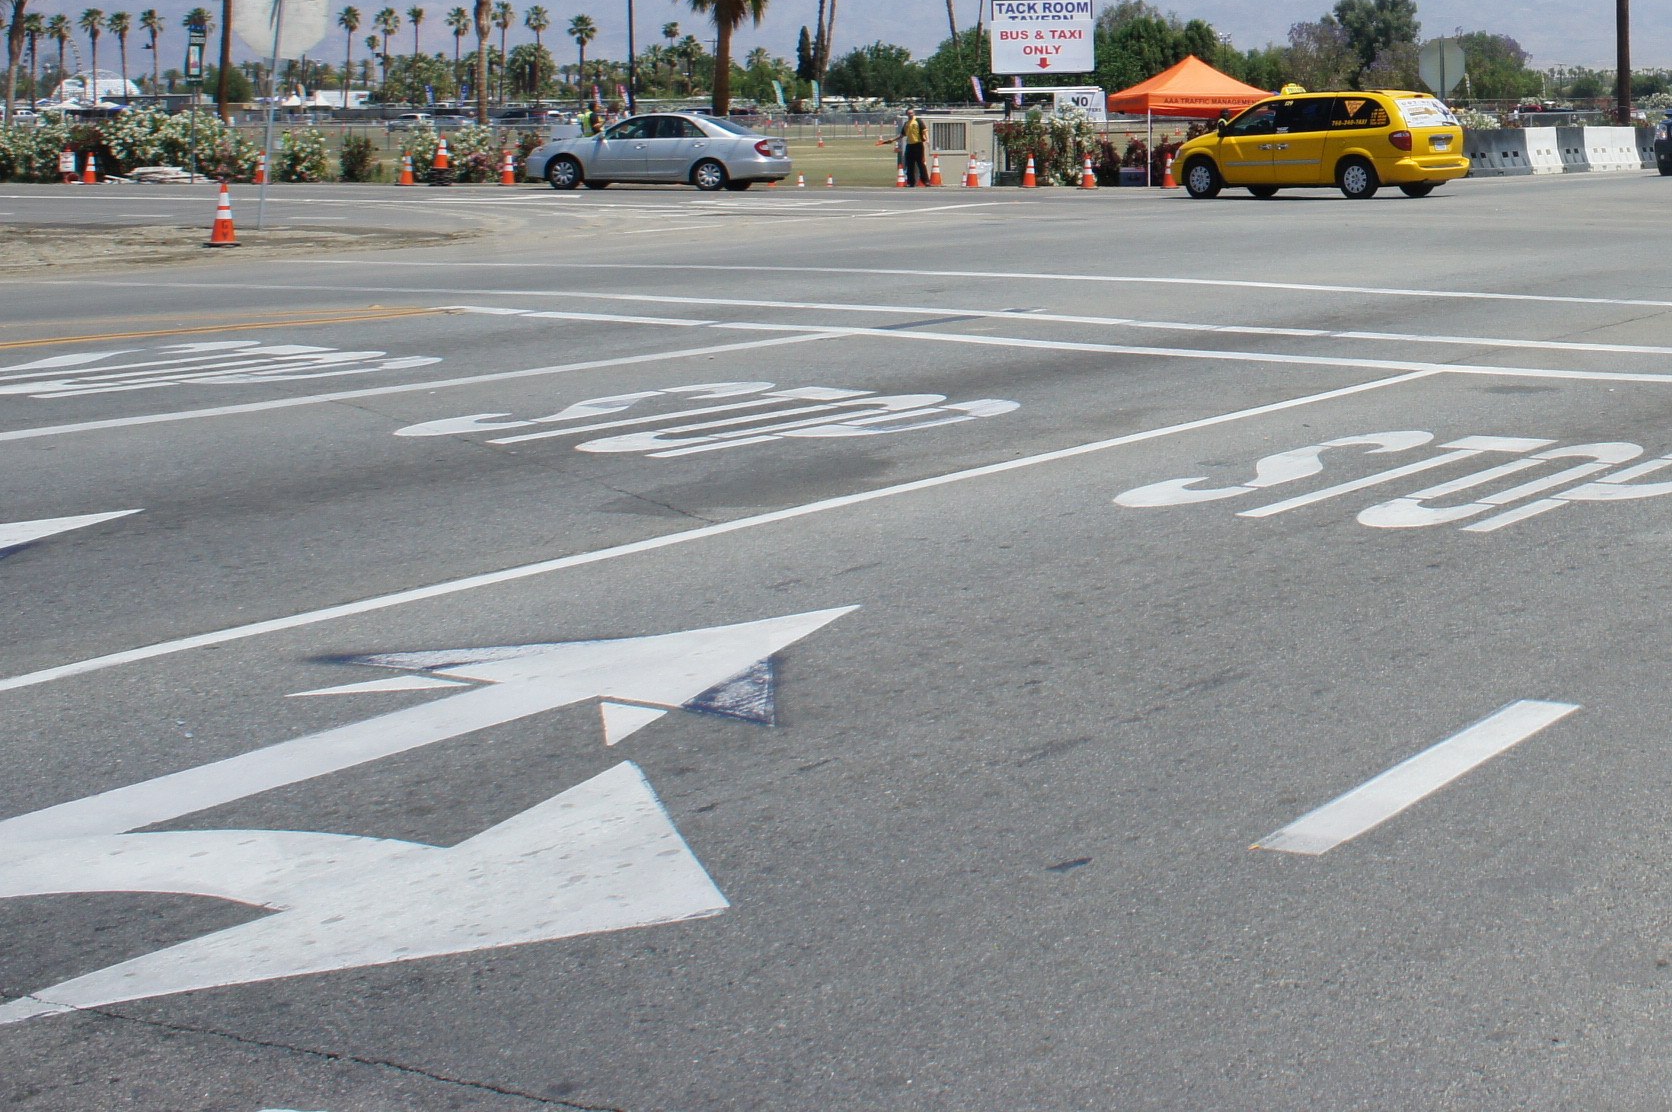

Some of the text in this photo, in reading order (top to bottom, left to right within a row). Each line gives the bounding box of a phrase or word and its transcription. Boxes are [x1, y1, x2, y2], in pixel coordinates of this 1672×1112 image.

[995, 1, 1089, 14] TACK ROOM
[1000, 29, 1083, 40] BUS & TAXI
[1023, 45, 1062, 56] ONLY
[1071, 96, 1089, 107] NO
[393, 381, 1021, 458] STOP
